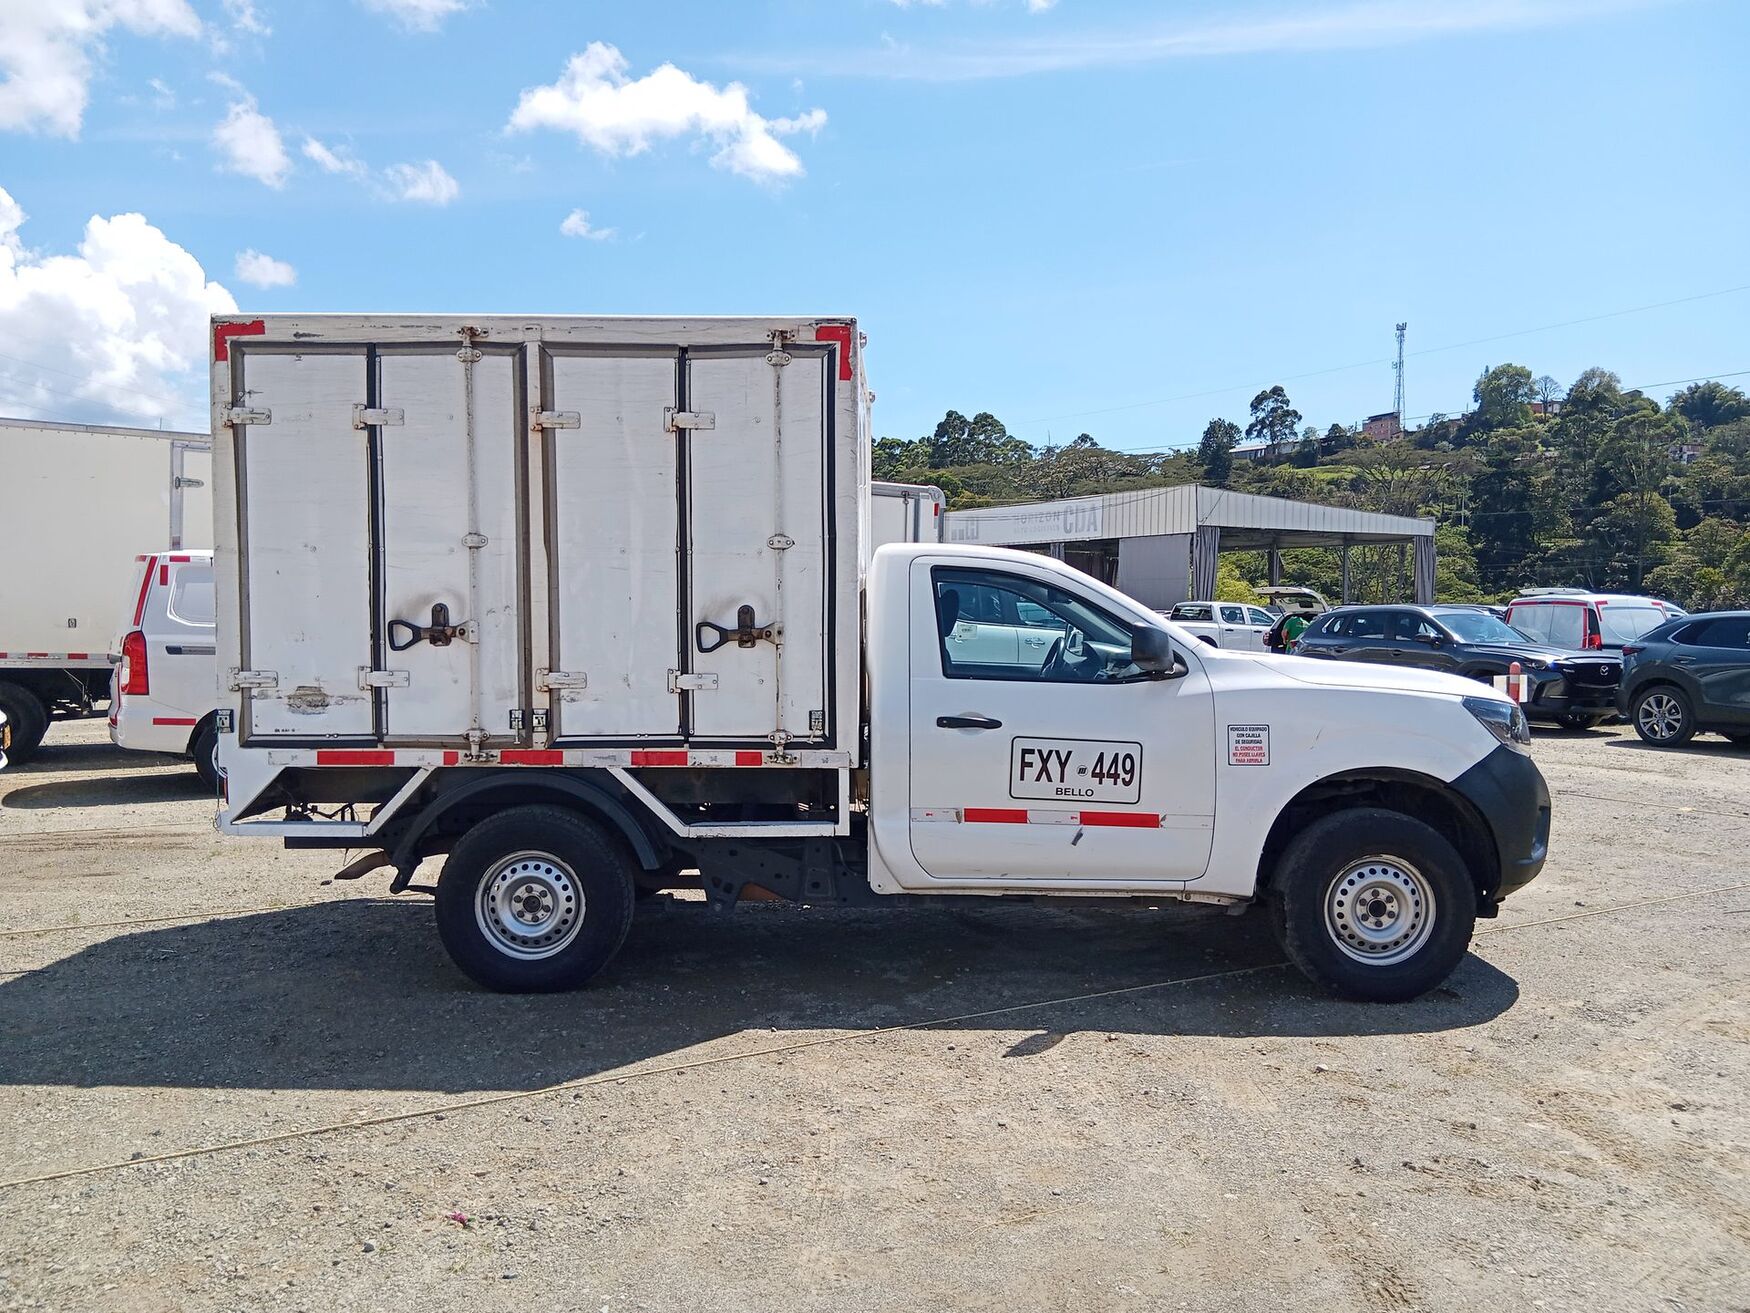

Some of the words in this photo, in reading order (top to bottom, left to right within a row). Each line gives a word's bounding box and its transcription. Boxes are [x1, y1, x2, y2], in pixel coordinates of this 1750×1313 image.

[1063, 504, 1098, 534] CDA
[1019, 748, 1073, 783] FXY
[1091, 752, 1135, 787] 449
[1055, 787, 1094, 797] BELLO
